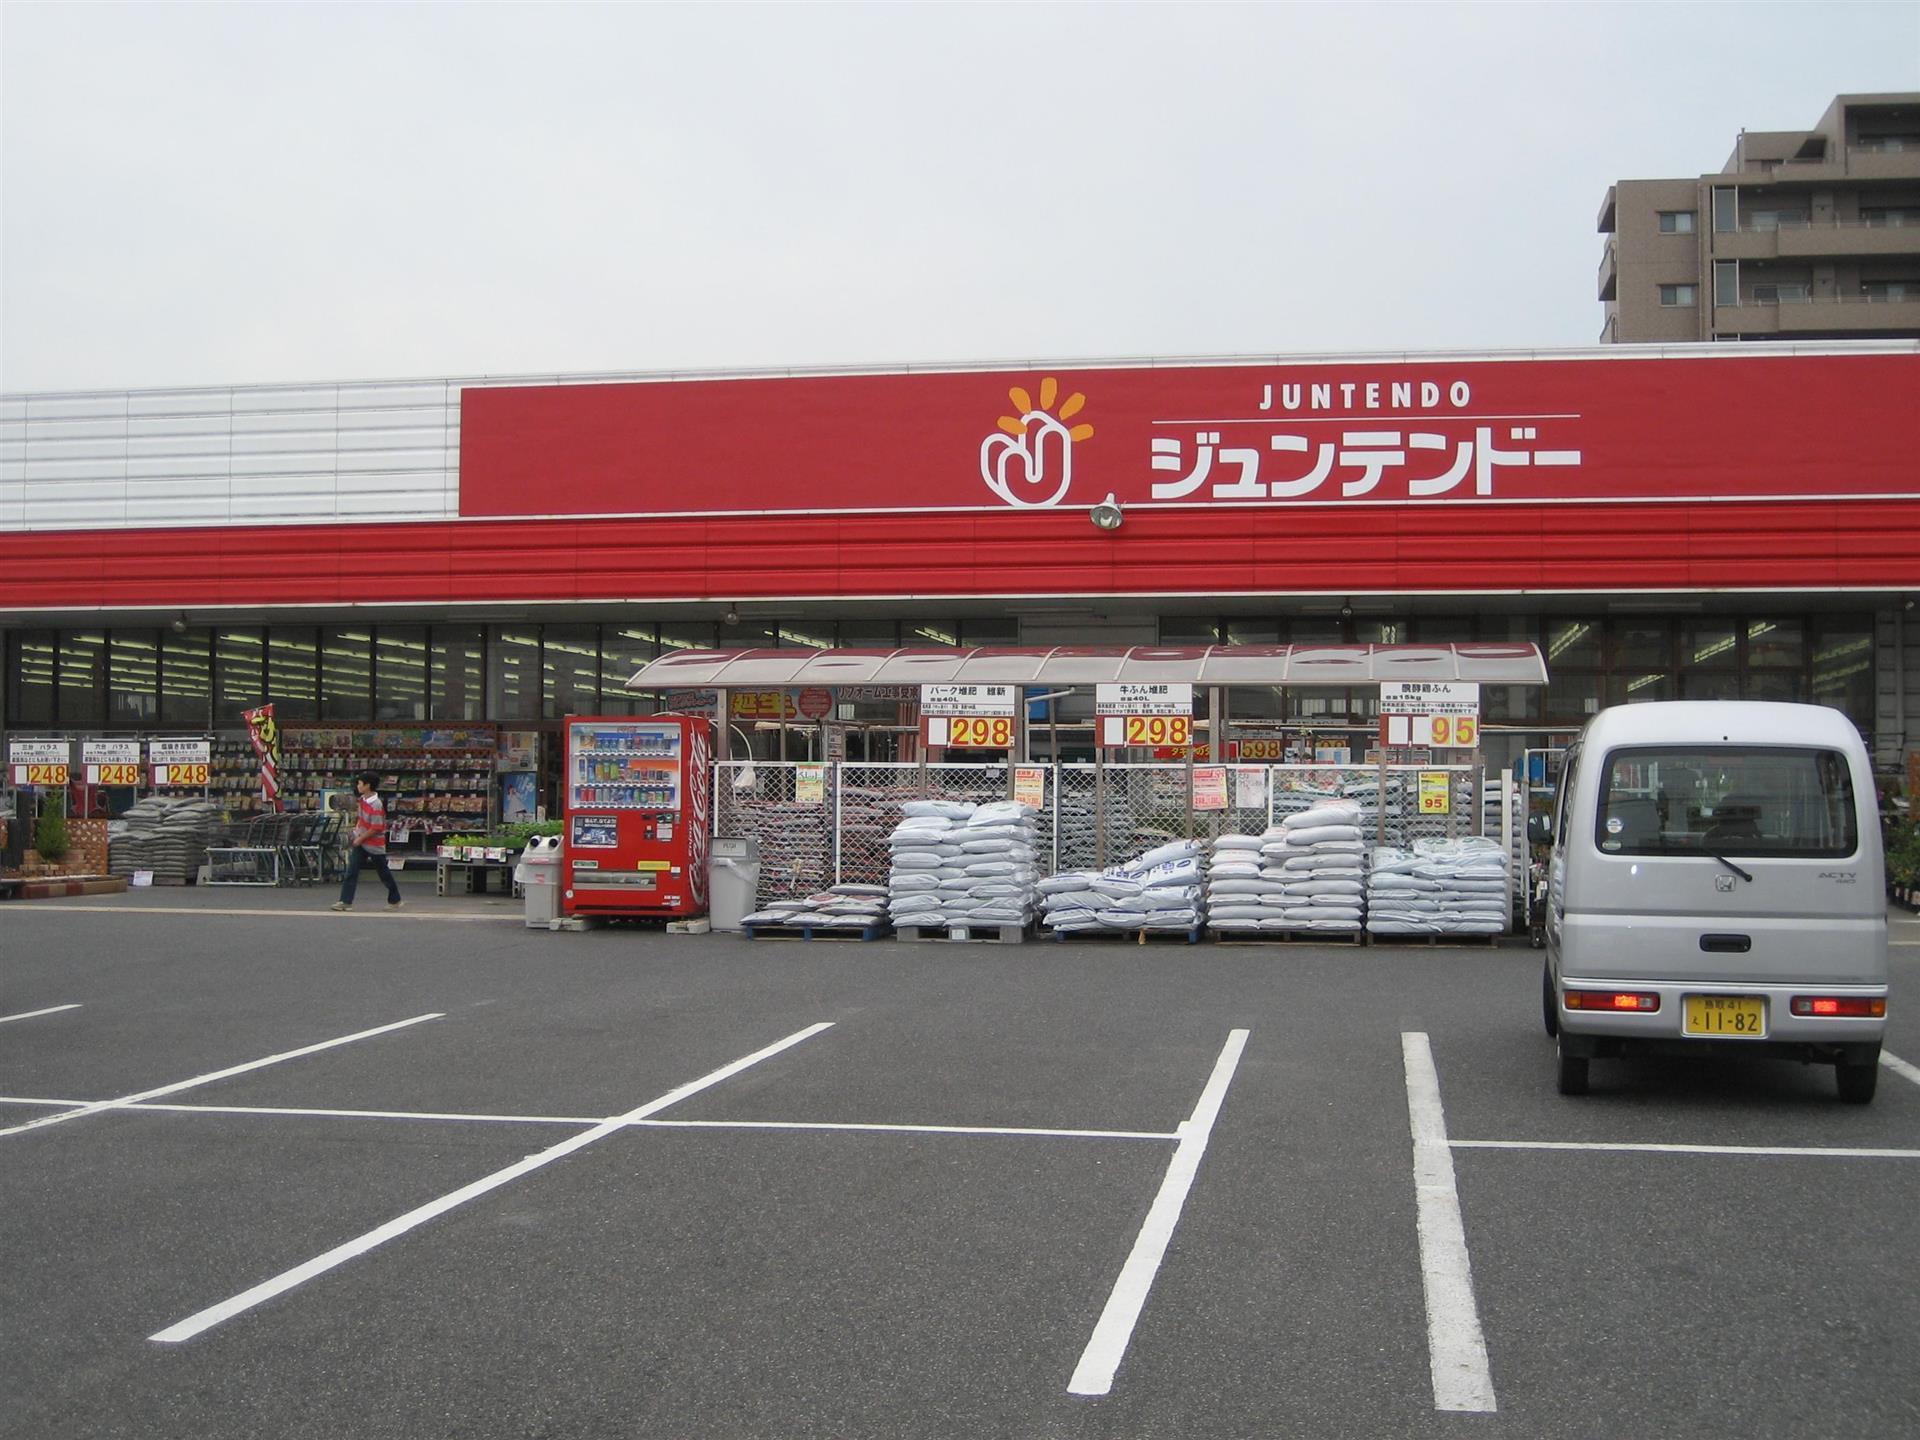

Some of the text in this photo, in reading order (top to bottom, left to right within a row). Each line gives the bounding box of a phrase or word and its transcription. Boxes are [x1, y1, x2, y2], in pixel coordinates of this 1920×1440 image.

[1259, 381, 1471, 410] JUNTENDO
[1151, 427, 1581, 499] ジュンテンドー
[930, 686, 977, 696] バーク堆肥
[1119, 685, 1169, 694] 牛ふん堆肥
[952, 718, 1009, 745] 298
[1128, 717, 1187, 744] 298
[1431, 716, 1474, 744] 95
[1242, 741, 1279, 758] 598
[30, 765, 66, 784] 248
[101, 765, 136, 784] 248
[170, 764, 207, 783] 248
[1425, 798, 1442, 808] 95
[1705, 1011, 1757, 1031] 11-82
